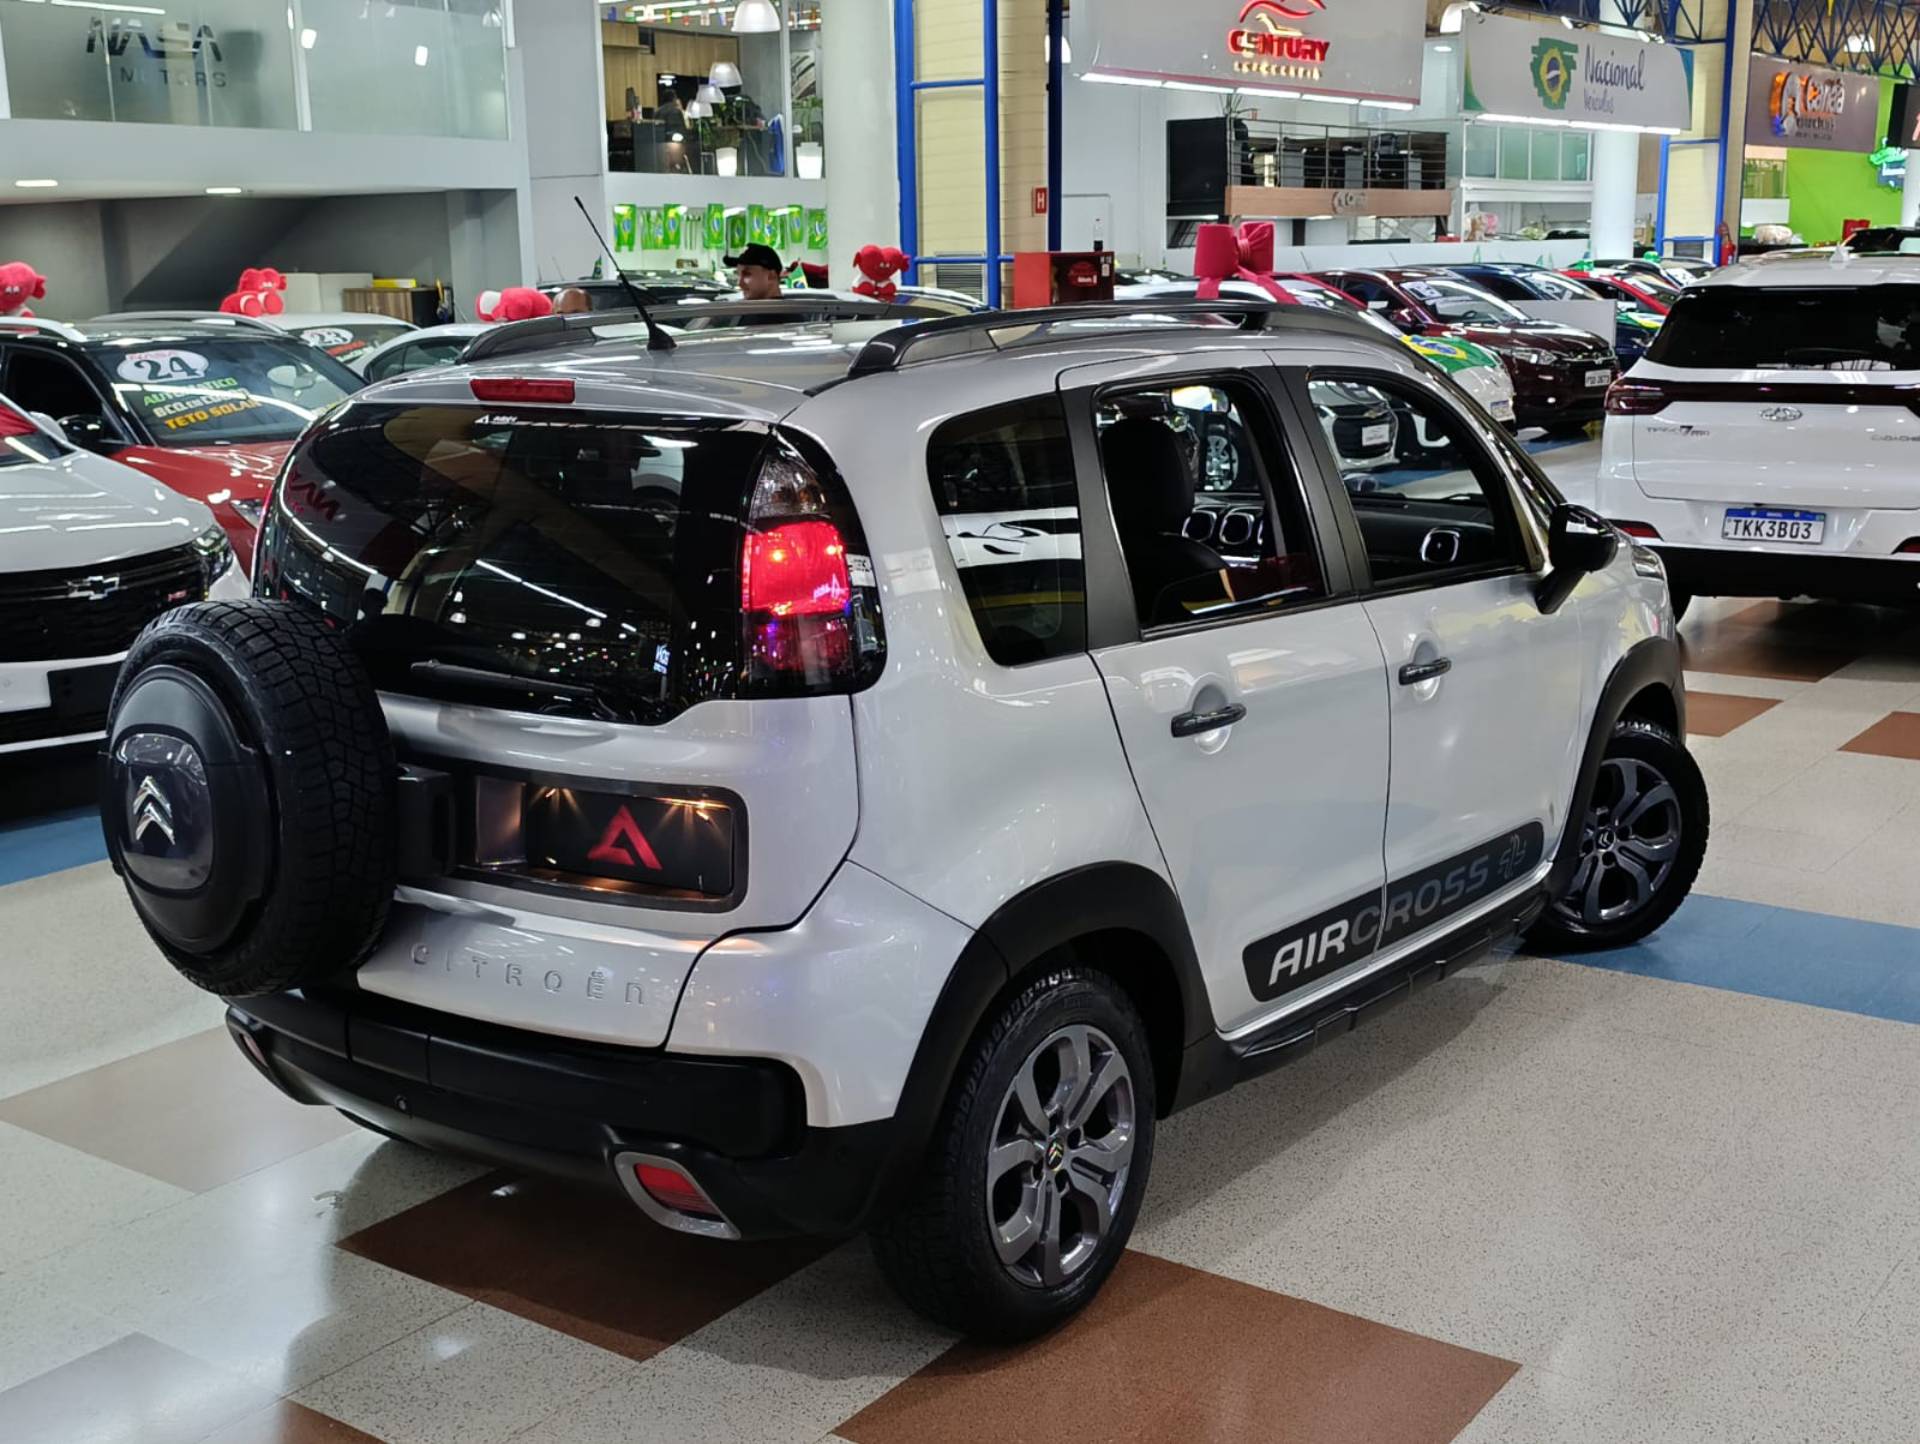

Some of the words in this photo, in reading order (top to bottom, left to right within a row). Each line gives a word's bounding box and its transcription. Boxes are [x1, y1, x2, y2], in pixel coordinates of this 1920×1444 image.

[1229, 29, 1330, 61] CENTURY
[1584, 43, 1645, 91] Nacional
[134, 356, 200, 380] 24
[164, 410, 209, 430] TETO
[1733, 519, 1813, 540] TKK3B03
[1268, 854, 1489, 986] AIRCROSS
